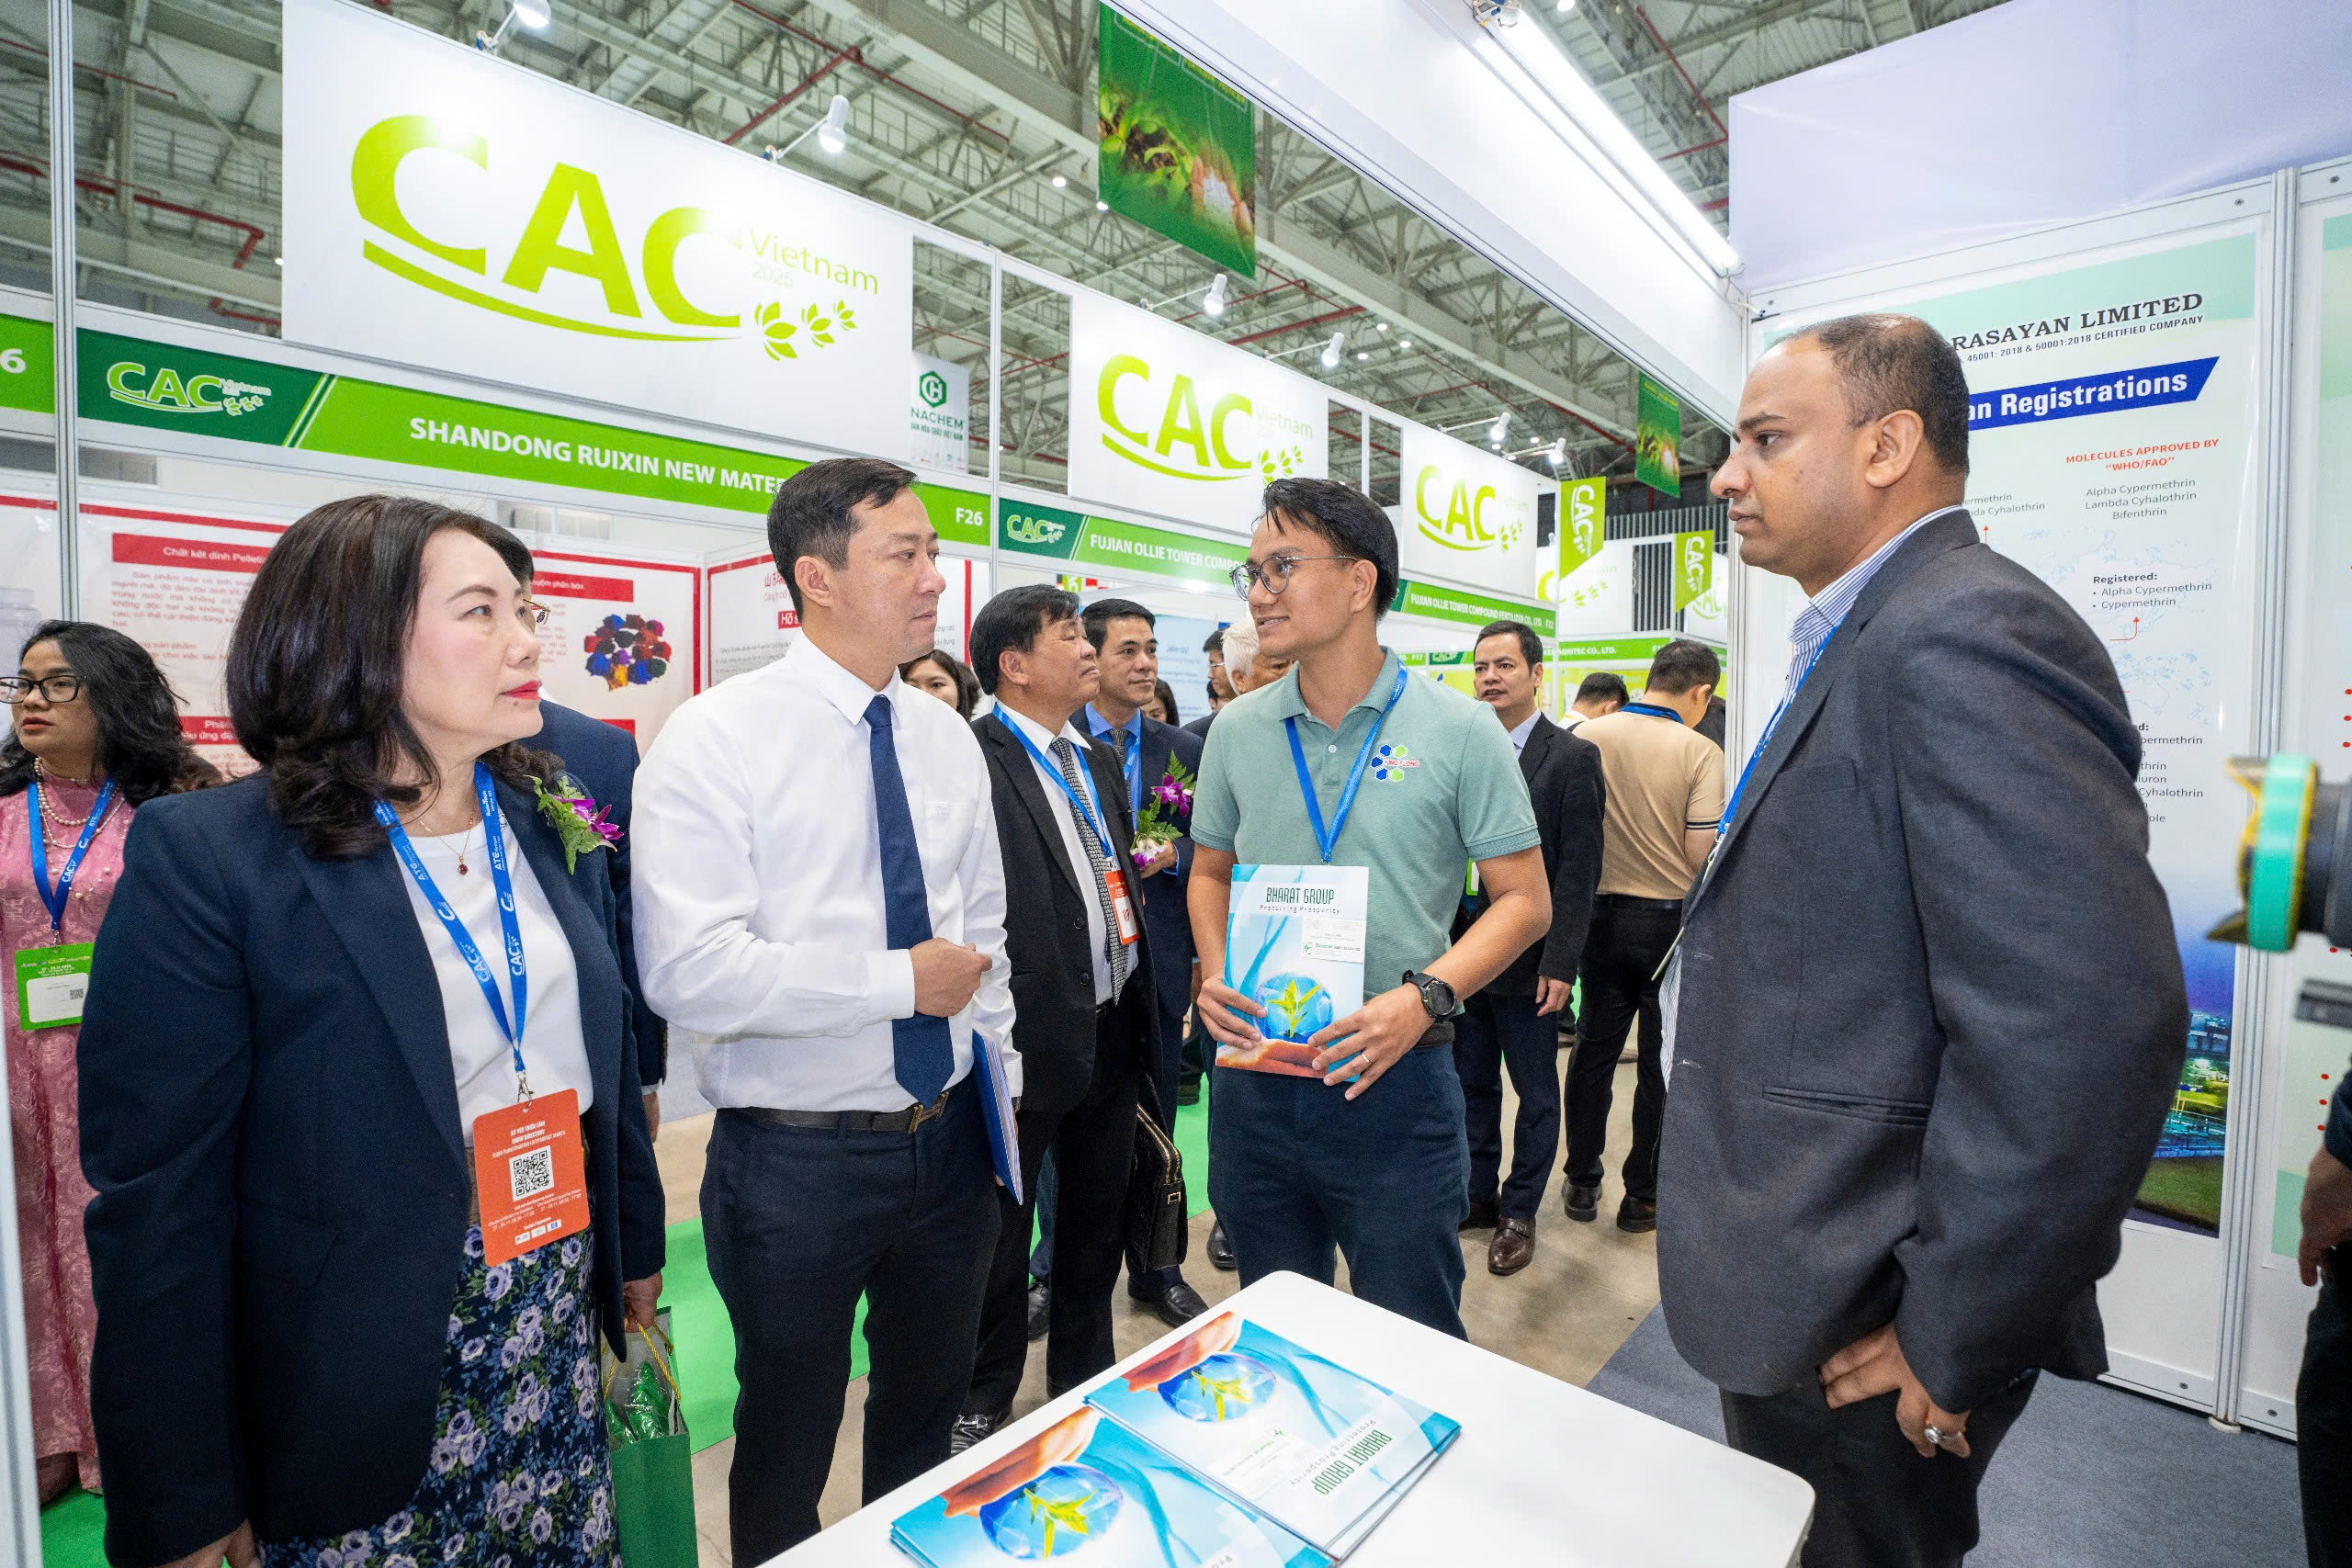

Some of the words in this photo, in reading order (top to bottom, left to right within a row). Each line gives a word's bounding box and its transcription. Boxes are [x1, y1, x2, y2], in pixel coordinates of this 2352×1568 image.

[351, 114, 741, 328] CAC
[749, 228, 879, 295] Vietnam
[1951, 316, 2071, 351] RASAYAN
[2080, 293, 2203, 330] LIMITED
[1967, 351, 1998, 363] 45001:
[2001, 345, 2023, 357] 2018
[2025, 344, 2033, 353] &
[2036, 334, 2092, 351] 50001:2018
[2095, 326, 2146, 341] CERTIFIED
[2149, 315, 2204, 332] COMPANY
[107, 361, 223, 410] CAC
[2000, 371, 2188, 419] Registrations
[1097, 354, 1252, 469] CAC
[409, 417, 572, 462] SHANDONG
[577, 445, 660, 476] RUIXIN
[664, 459, 716, 485] NEW
[2065, 448, 2133, 464] MOLECULES
[2135, 441, 2200, 457] APPROVED
[2203, 438, 2220, 448] BY
[1416, 465, 1496, 541] CAC
[2085, 497, 2129, 510] Lambda
[2132, 491, 2198, 506] Cyhalothrin
[2086, 485, 2118, 498] Alpha
[2120, 478, 2197, 495] Cypermethrin
[955, 507, 984, 527] F26
[1573, 485, 1595, 536] CAC
[1987, 502, 2046, 516] Cyhalothrin
[2112, 507, 2167, 520] Bifenthrin
[1007, 514, 1048, 540] CAC
[1090, 534, 1133, 554] FUJIAN
[1134, 542, 1166, 560] OLLIE
[1167, 547, 1203, 567] TOWER
[1687, 536, 1706, 576] CAC
[2093, 572, 2158, 585] Registered:
[2101, 586, 2132, 597] Alpha
[2134, 582, 2212, 596] Cypermethrin
[1411, 593, 1433, 606] FUJIAN
[1433, 598, 1449, 610] OLLIE
[1450, 601, 1469, 614] TOWER
[1469, 604, 1499, 618] COMPOUND
[2101, 598, 2177, 610] Cypermethrin
[1601, 646, 1617, 654] LTD.
[2138, 787, 2204, 798] Cyhalothrin
[1266, 886, 1302, 904] BHARAT
[1304, 888, 1335, 905] GROUP
[508, 945, 524, 976] CAC
[1343, 1428, 1393, 1467] BHARAT
[1311, 1459, 1355, 1495] GROUP
